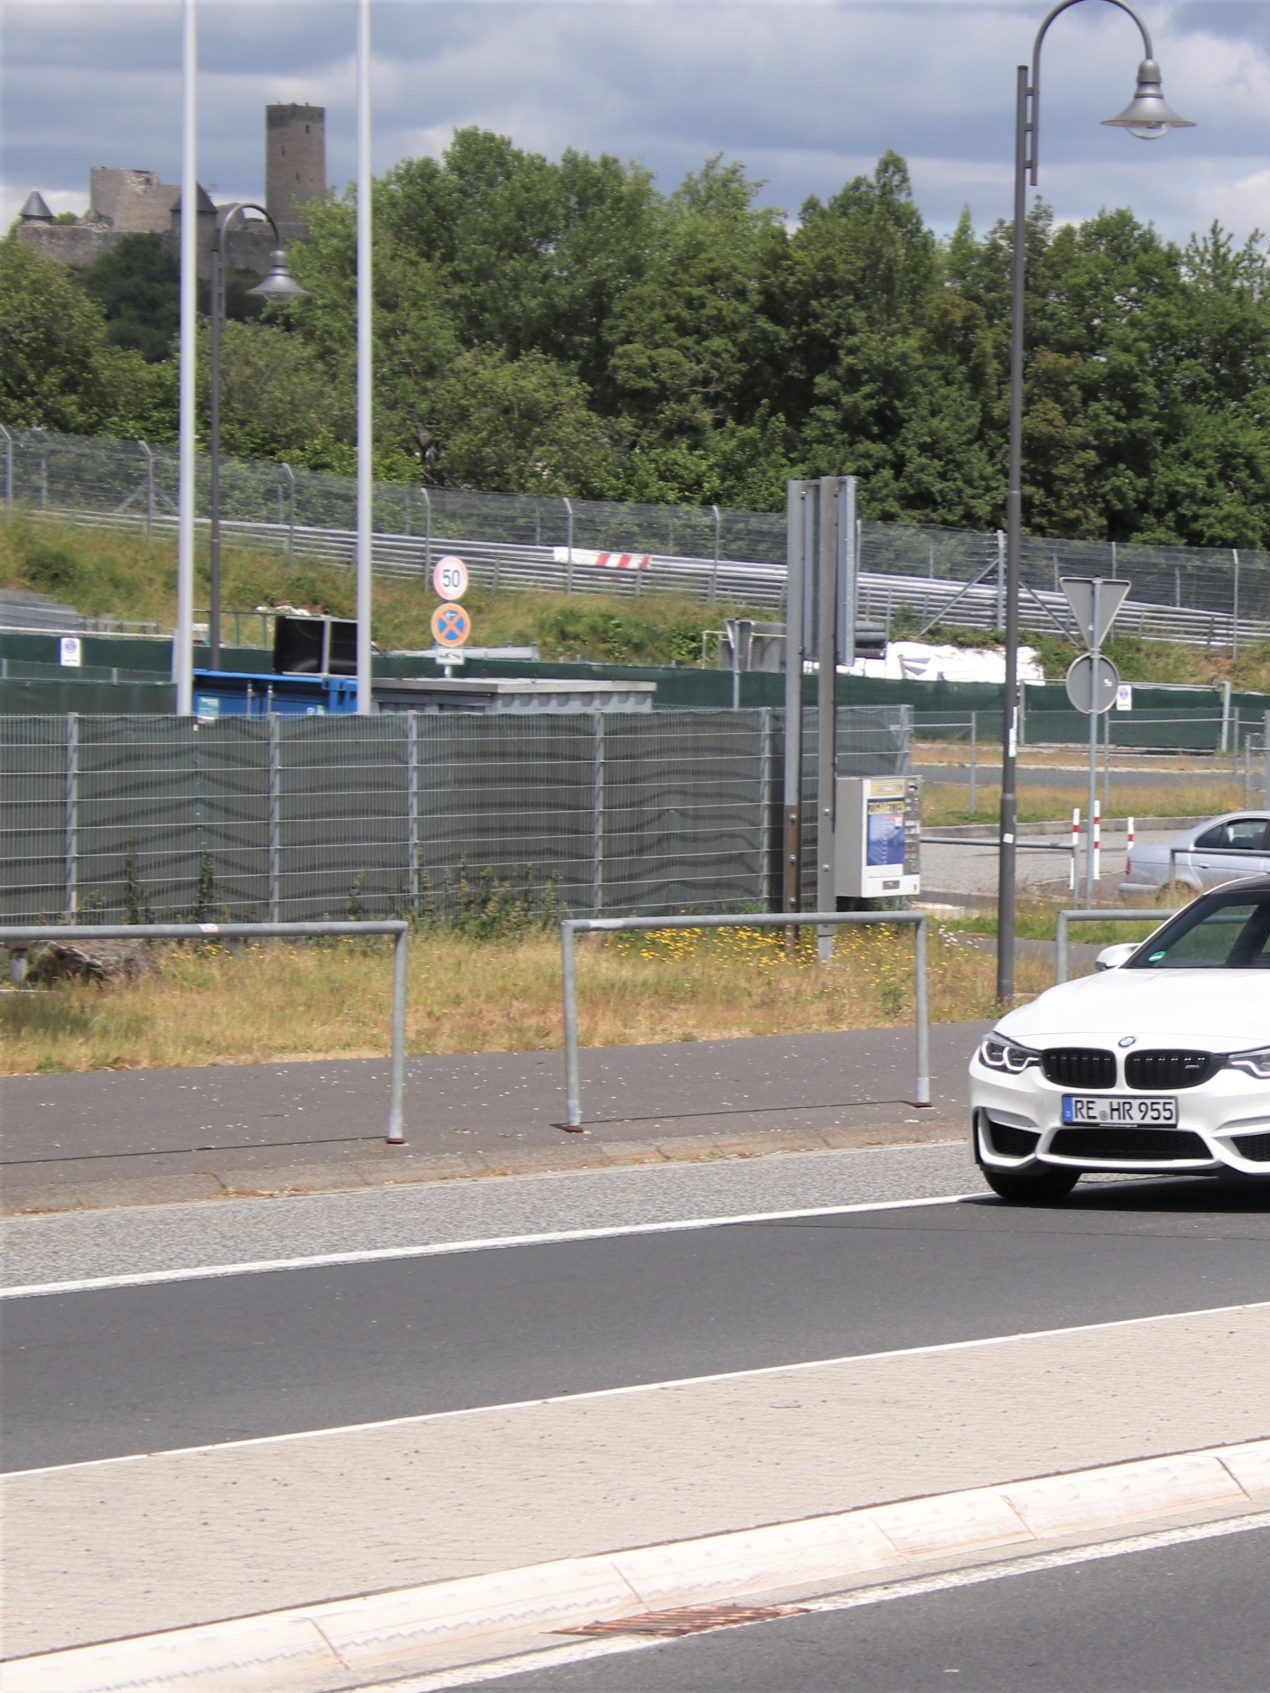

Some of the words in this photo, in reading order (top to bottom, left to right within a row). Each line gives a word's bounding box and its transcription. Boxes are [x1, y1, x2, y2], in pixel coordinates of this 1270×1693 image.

[442, 569, 461, 588] 50
[1074, 1100, 1098, 1120] RE
[1110, 1101, 1134, 1121] HR
[1138, 1101, 1174, 1121] 955
